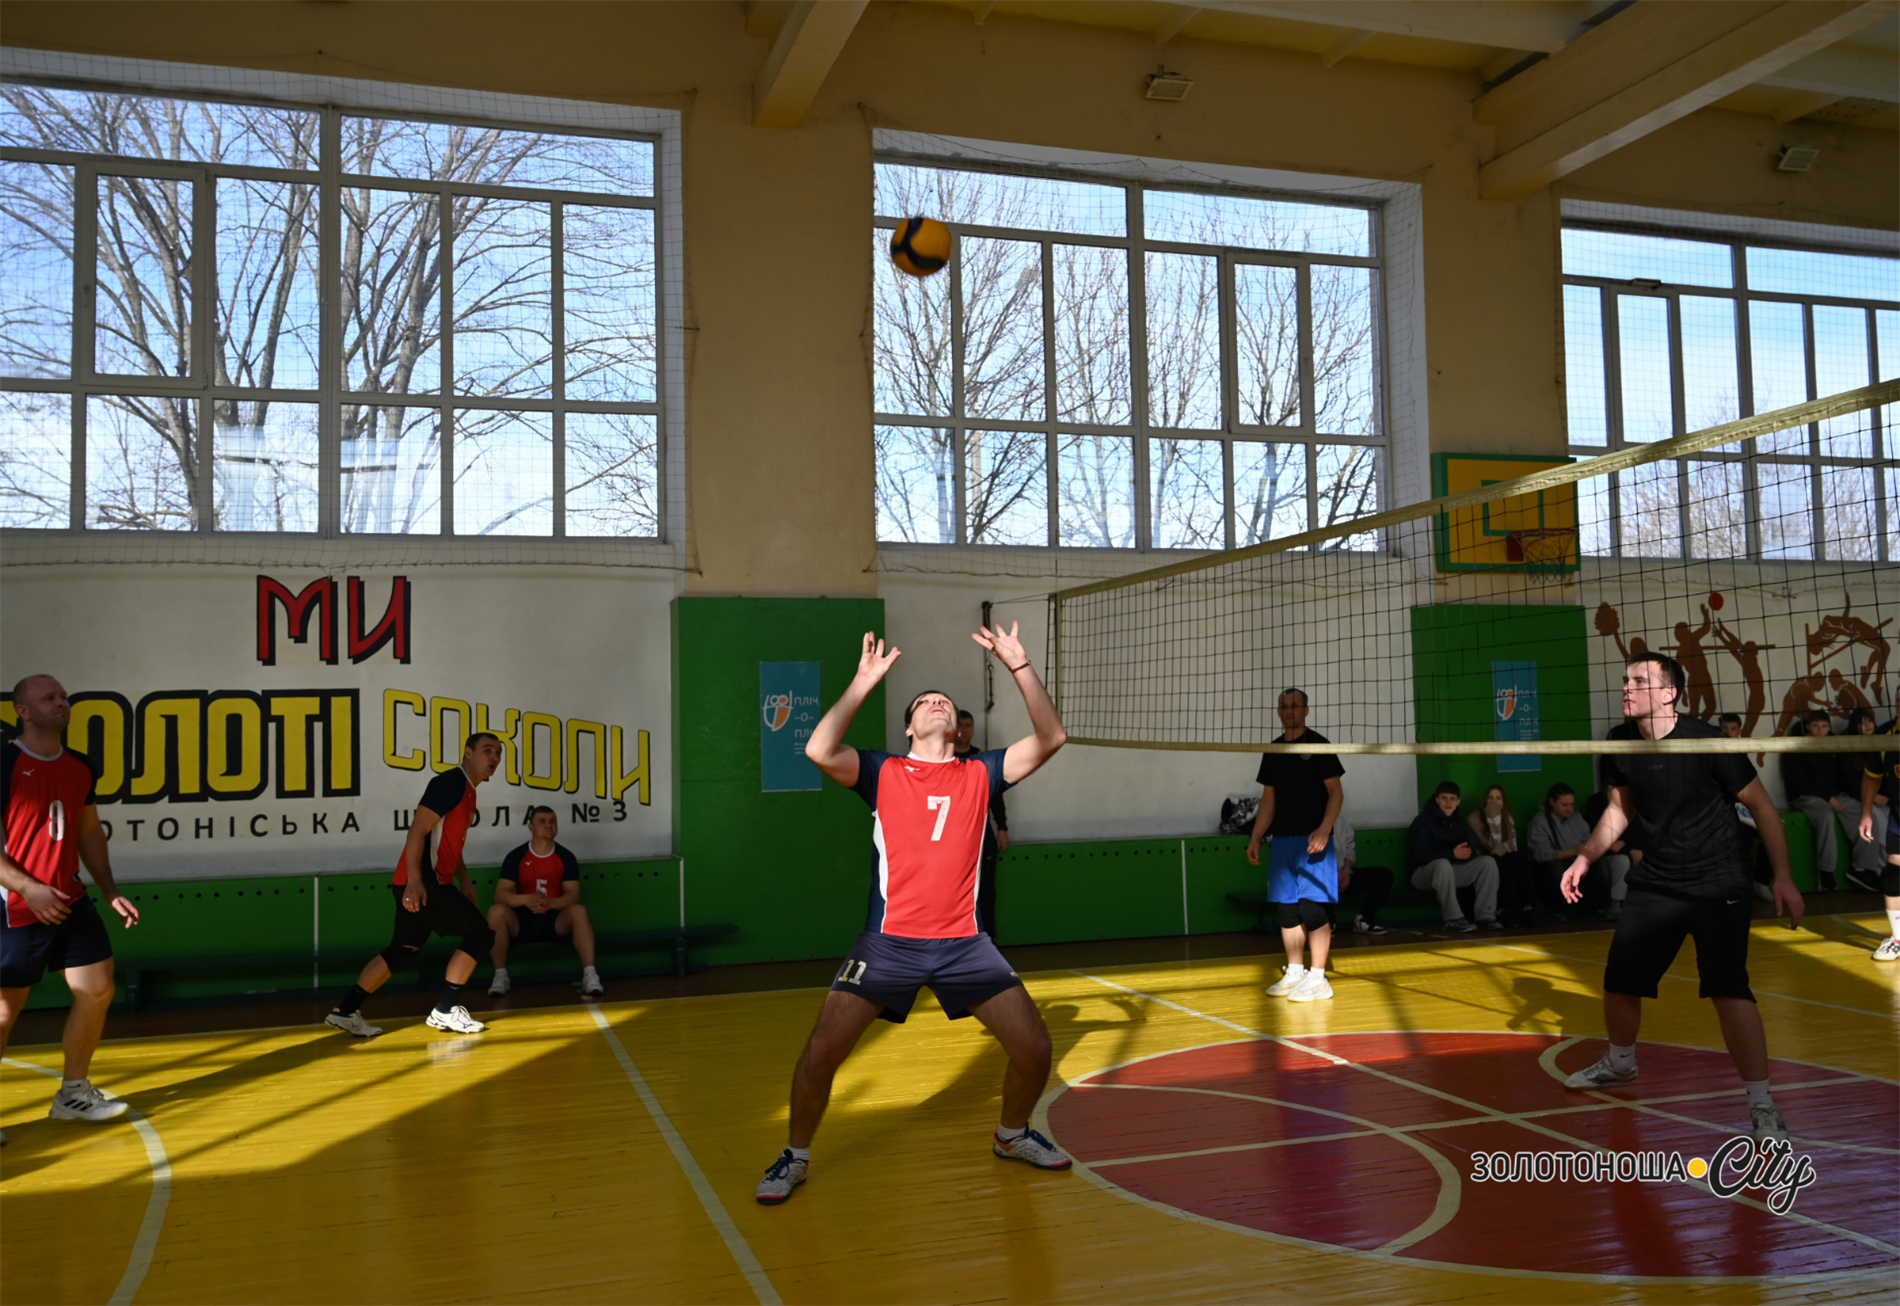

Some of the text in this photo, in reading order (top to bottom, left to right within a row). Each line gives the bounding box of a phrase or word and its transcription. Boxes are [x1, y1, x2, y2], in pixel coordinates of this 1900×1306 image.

[257, 575, 410, 665] МИ
[794, 696, 818, 706] ПЛІЧ
[383, 688, 651, 806] СОКОЛИ
[794, 729, 813, 739] ПЛІ
[48, 799, 65, 841] 8
[394, 805, 535, 831] ШЛА
[572, 803, 600, 824] №
[613, 800, 628, 821] 3
[927, 796, 951, 841] 7
[536, 878, 548, 897] 5
[837, 959, 867, 986] 11
